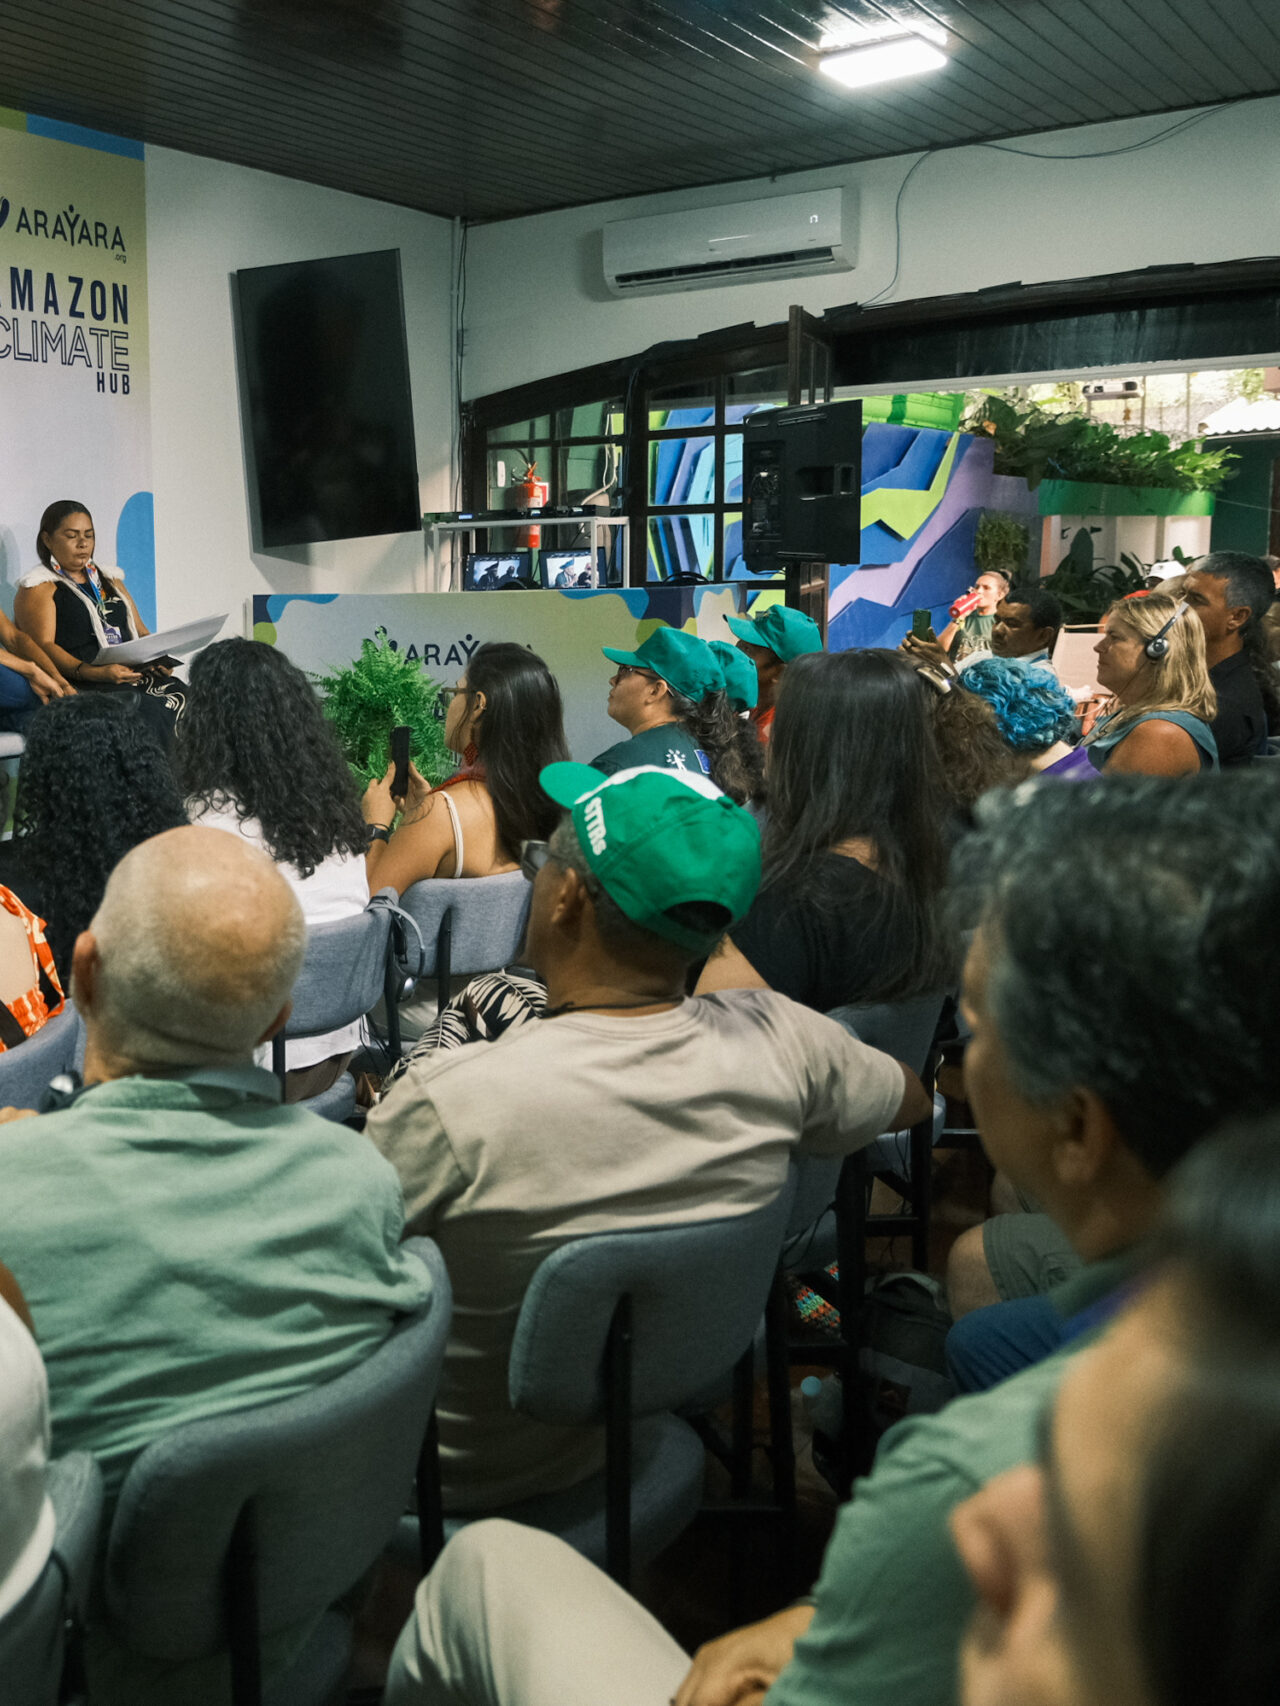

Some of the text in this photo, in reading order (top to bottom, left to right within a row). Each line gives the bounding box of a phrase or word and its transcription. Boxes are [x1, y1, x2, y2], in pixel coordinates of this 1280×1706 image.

[15, 204, 126, 252] ARAYARA
[96, 372, 130, 395] HUB
[404, 634, 533, 667] ARAY
